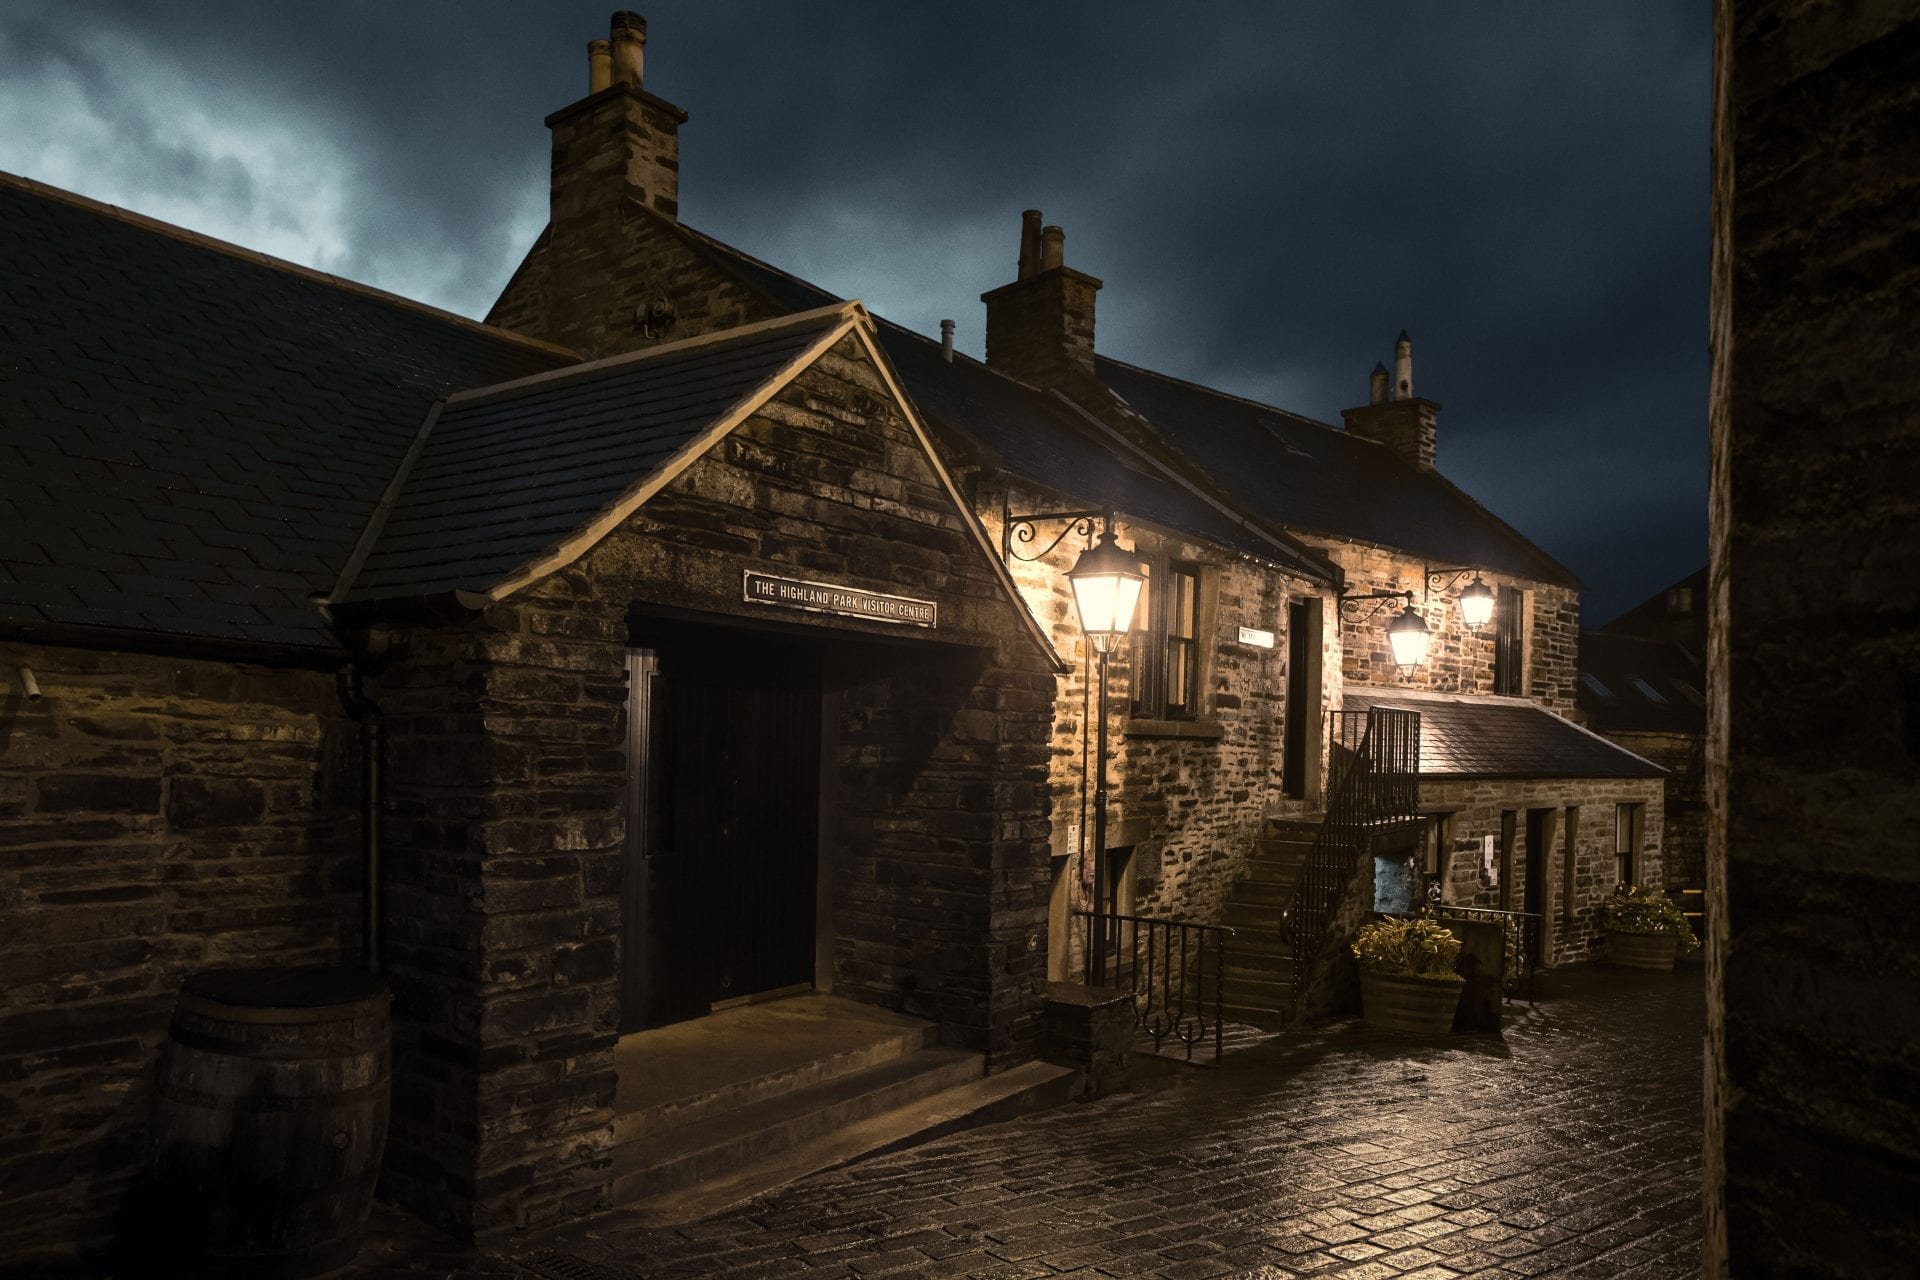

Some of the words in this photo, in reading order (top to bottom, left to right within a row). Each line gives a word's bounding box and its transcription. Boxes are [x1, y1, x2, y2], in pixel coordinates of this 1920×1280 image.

[755, 580, 775, 596] THE
[780, 585, 828, 604] HIGHLAND
[833, 593, 858, 609] PARK
[862, 598, 895, 614] VISITOR
[898, 604, 929, 620] CENTRE
